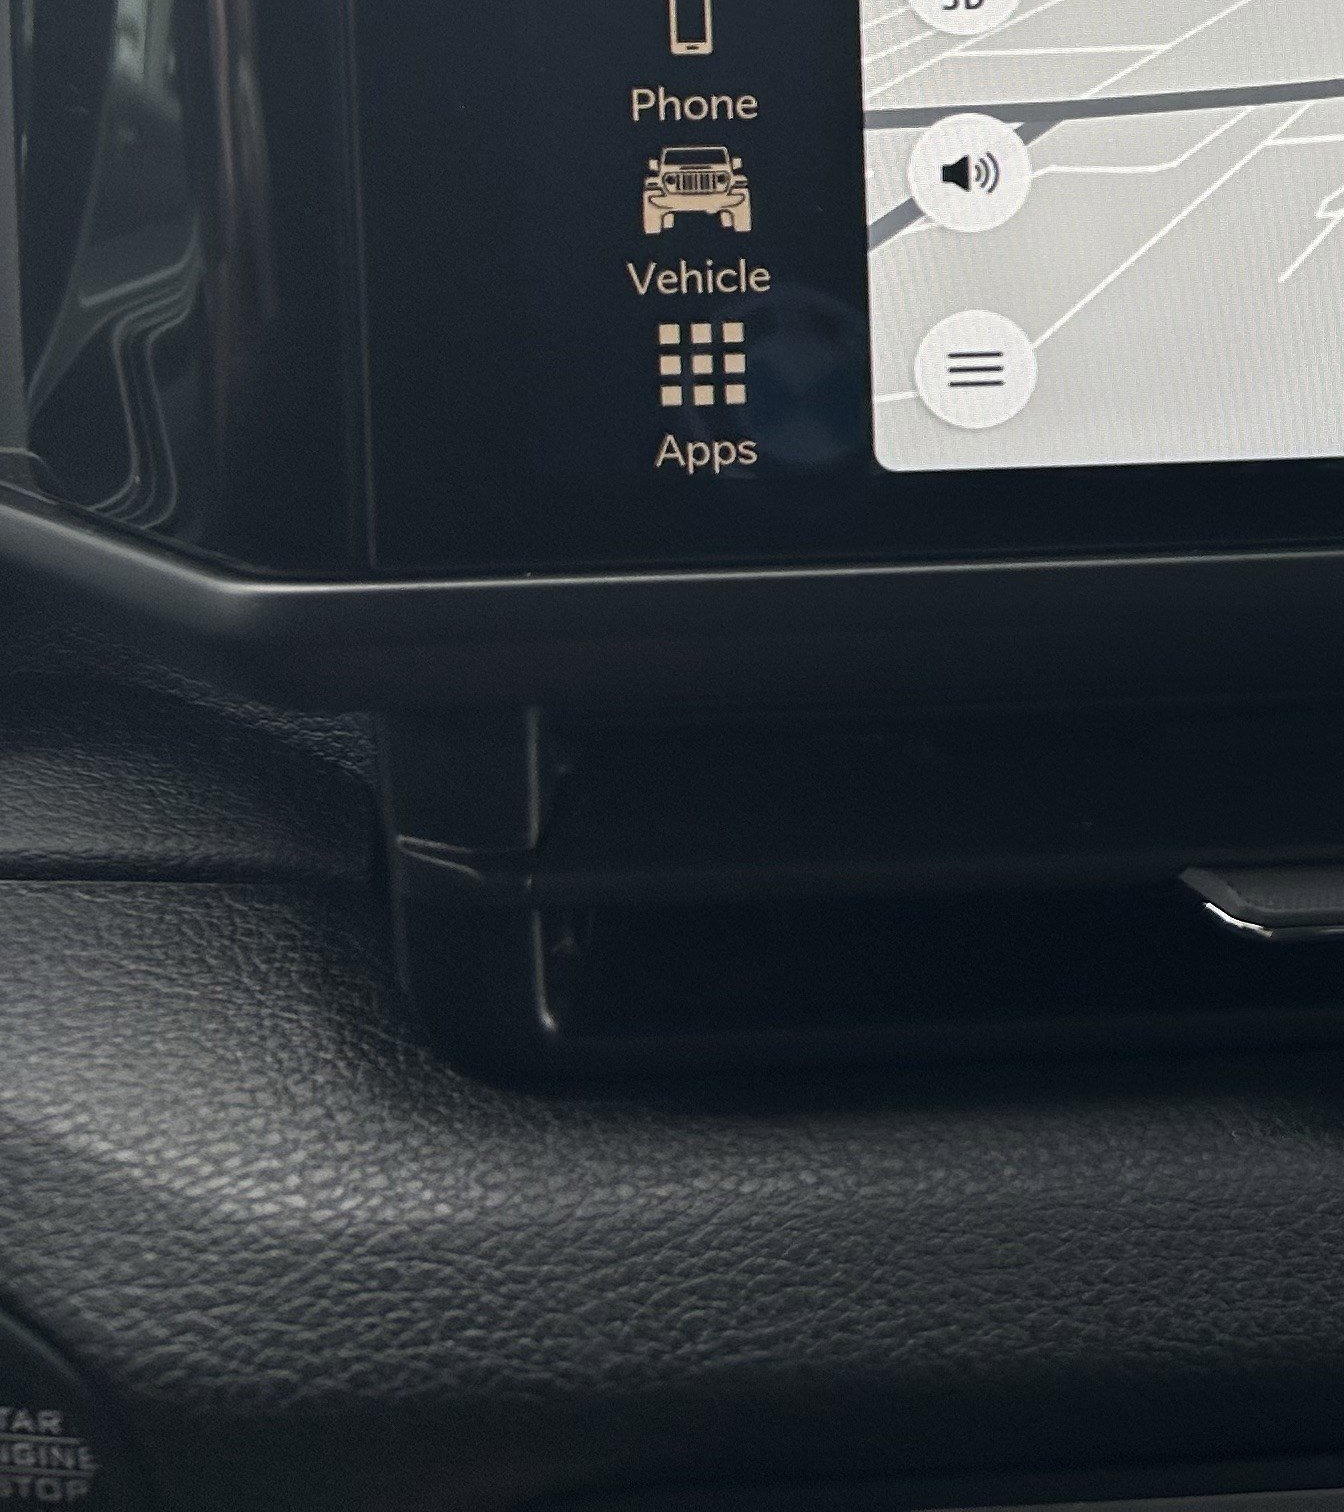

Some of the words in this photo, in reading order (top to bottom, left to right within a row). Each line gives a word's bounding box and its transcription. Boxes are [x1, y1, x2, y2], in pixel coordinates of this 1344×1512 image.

[631, 86, 758, 122] Phone
[626, 258, 771, 296] Vehicle
[655, 434, 758, 475] Apps
